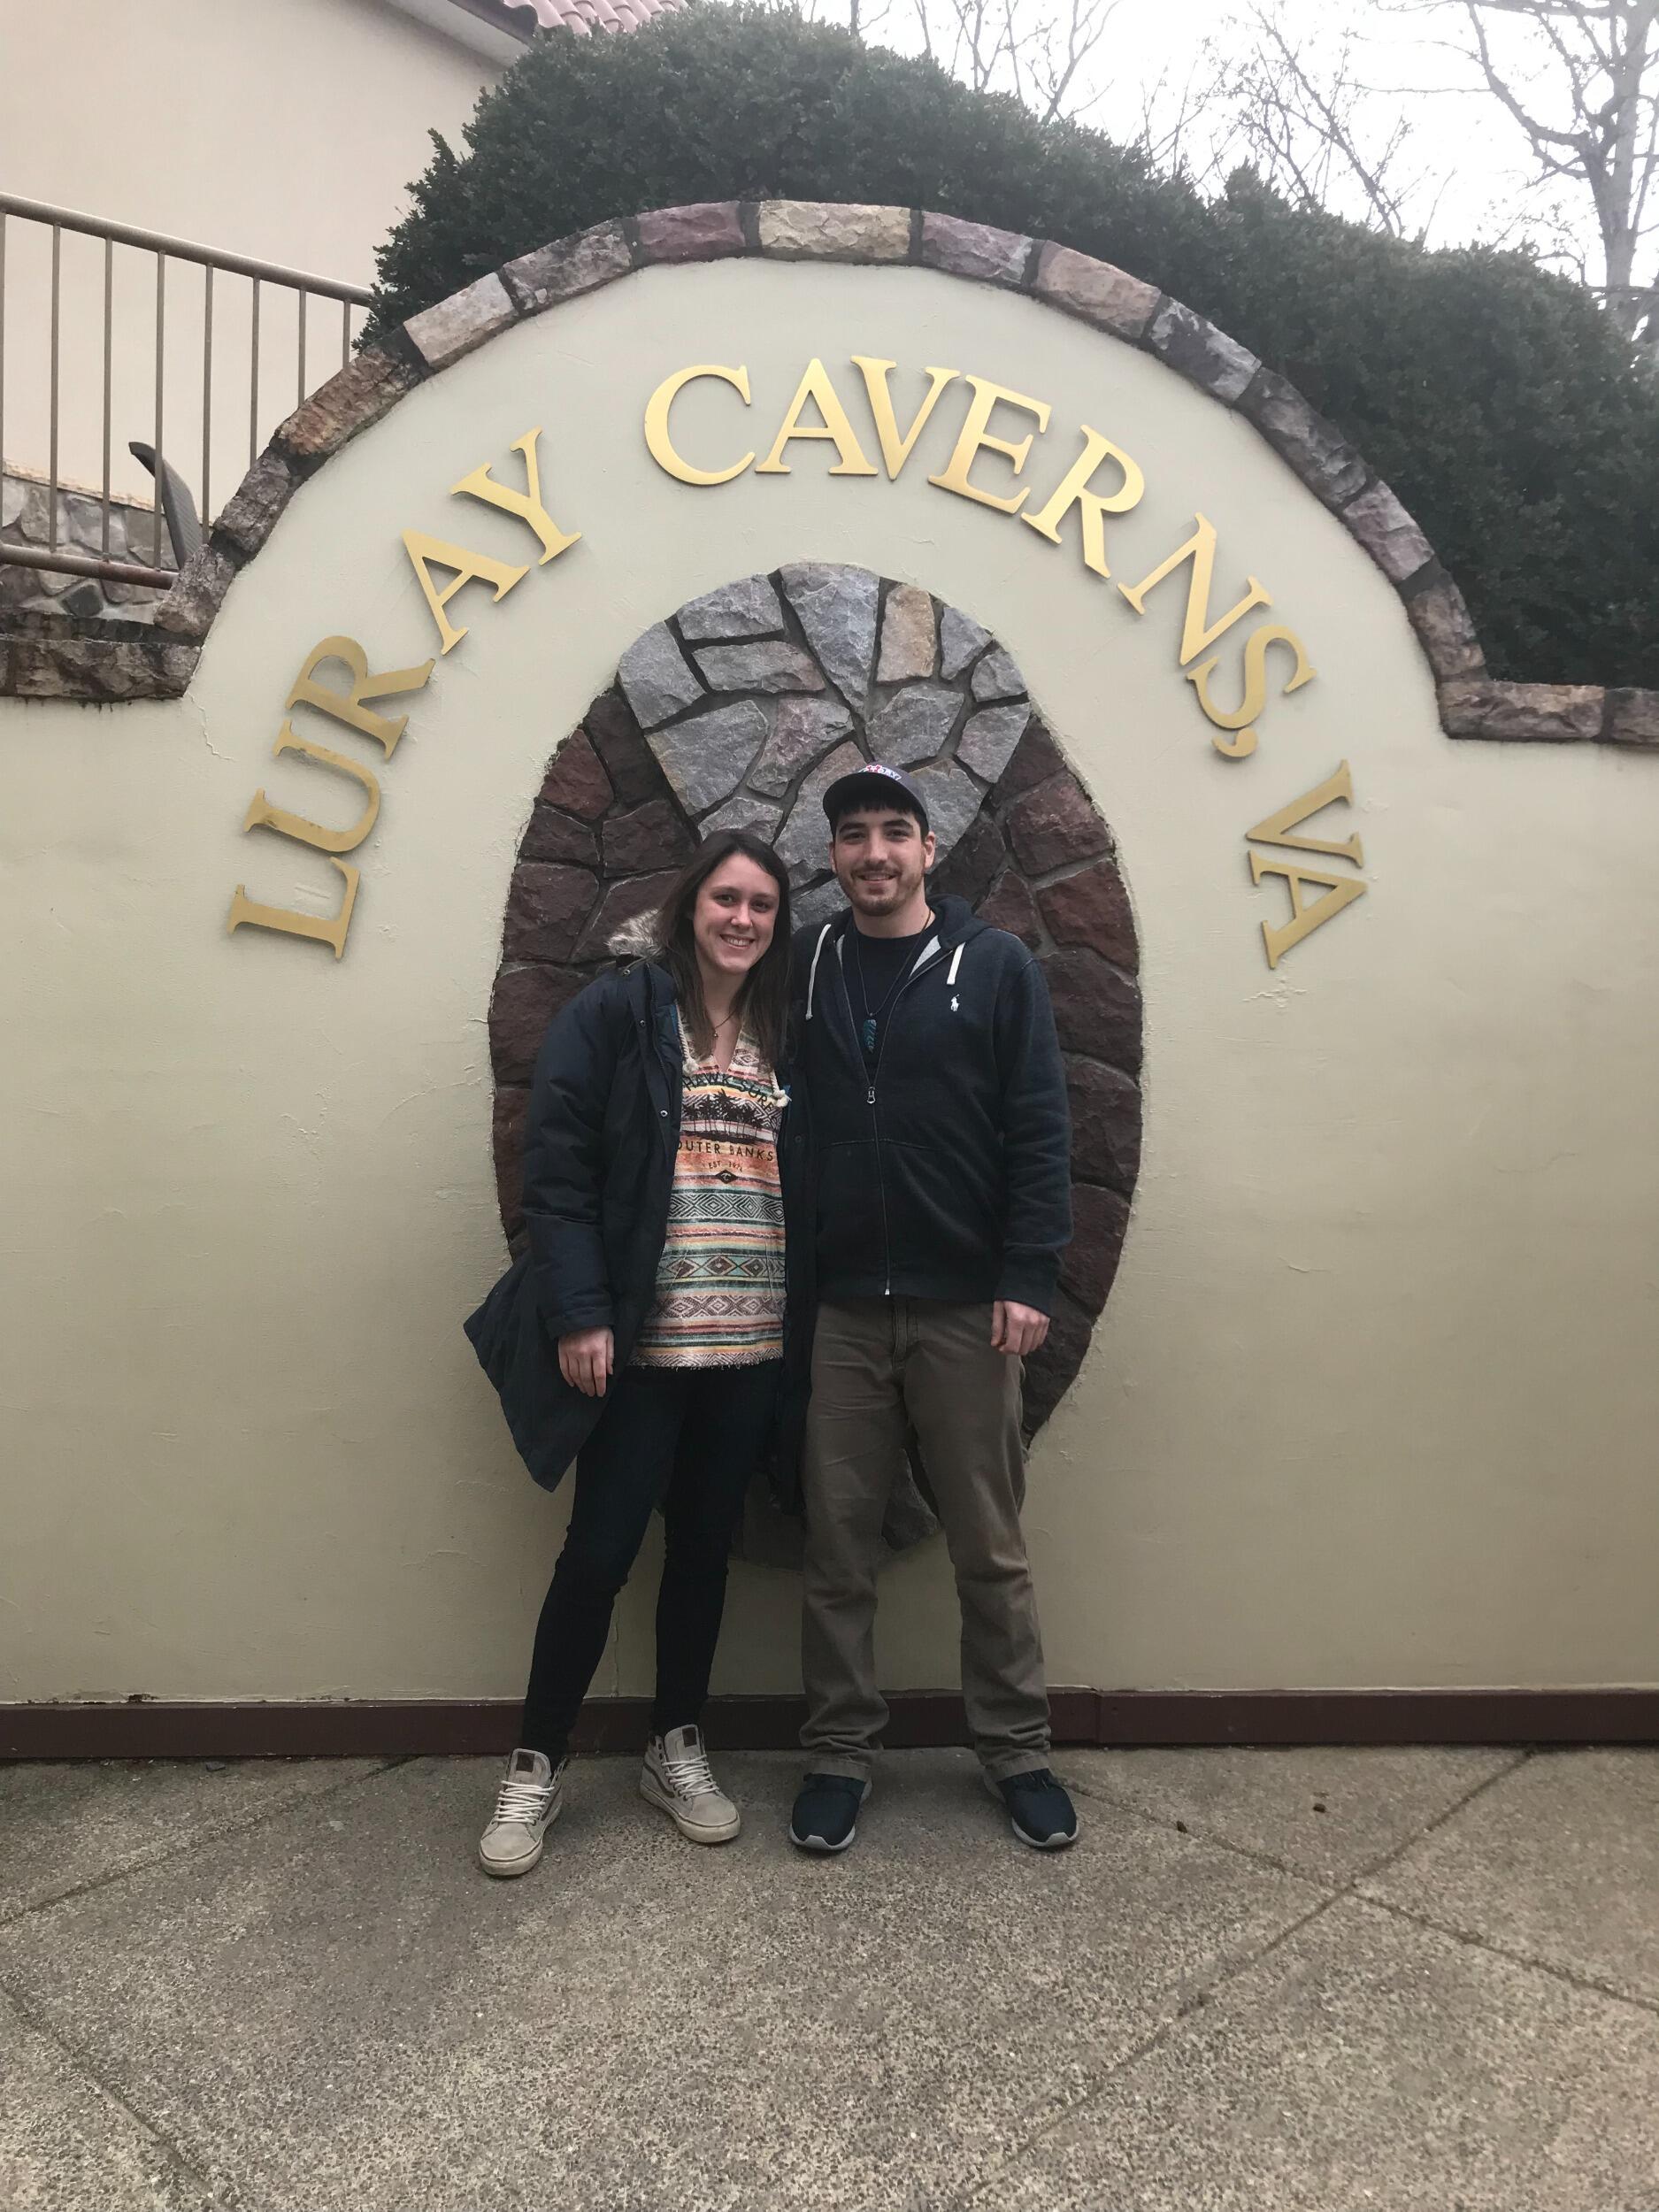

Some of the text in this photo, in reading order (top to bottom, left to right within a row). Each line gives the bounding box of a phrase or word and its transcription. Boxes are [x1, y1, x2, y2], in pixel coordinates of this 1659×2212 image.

[227, 356, 1367, 969] LURAY CAVERNS, VA
[682, 1072, 774, 1110] HAWK SURF
[729, 1145, 774, 1161] BANKS
